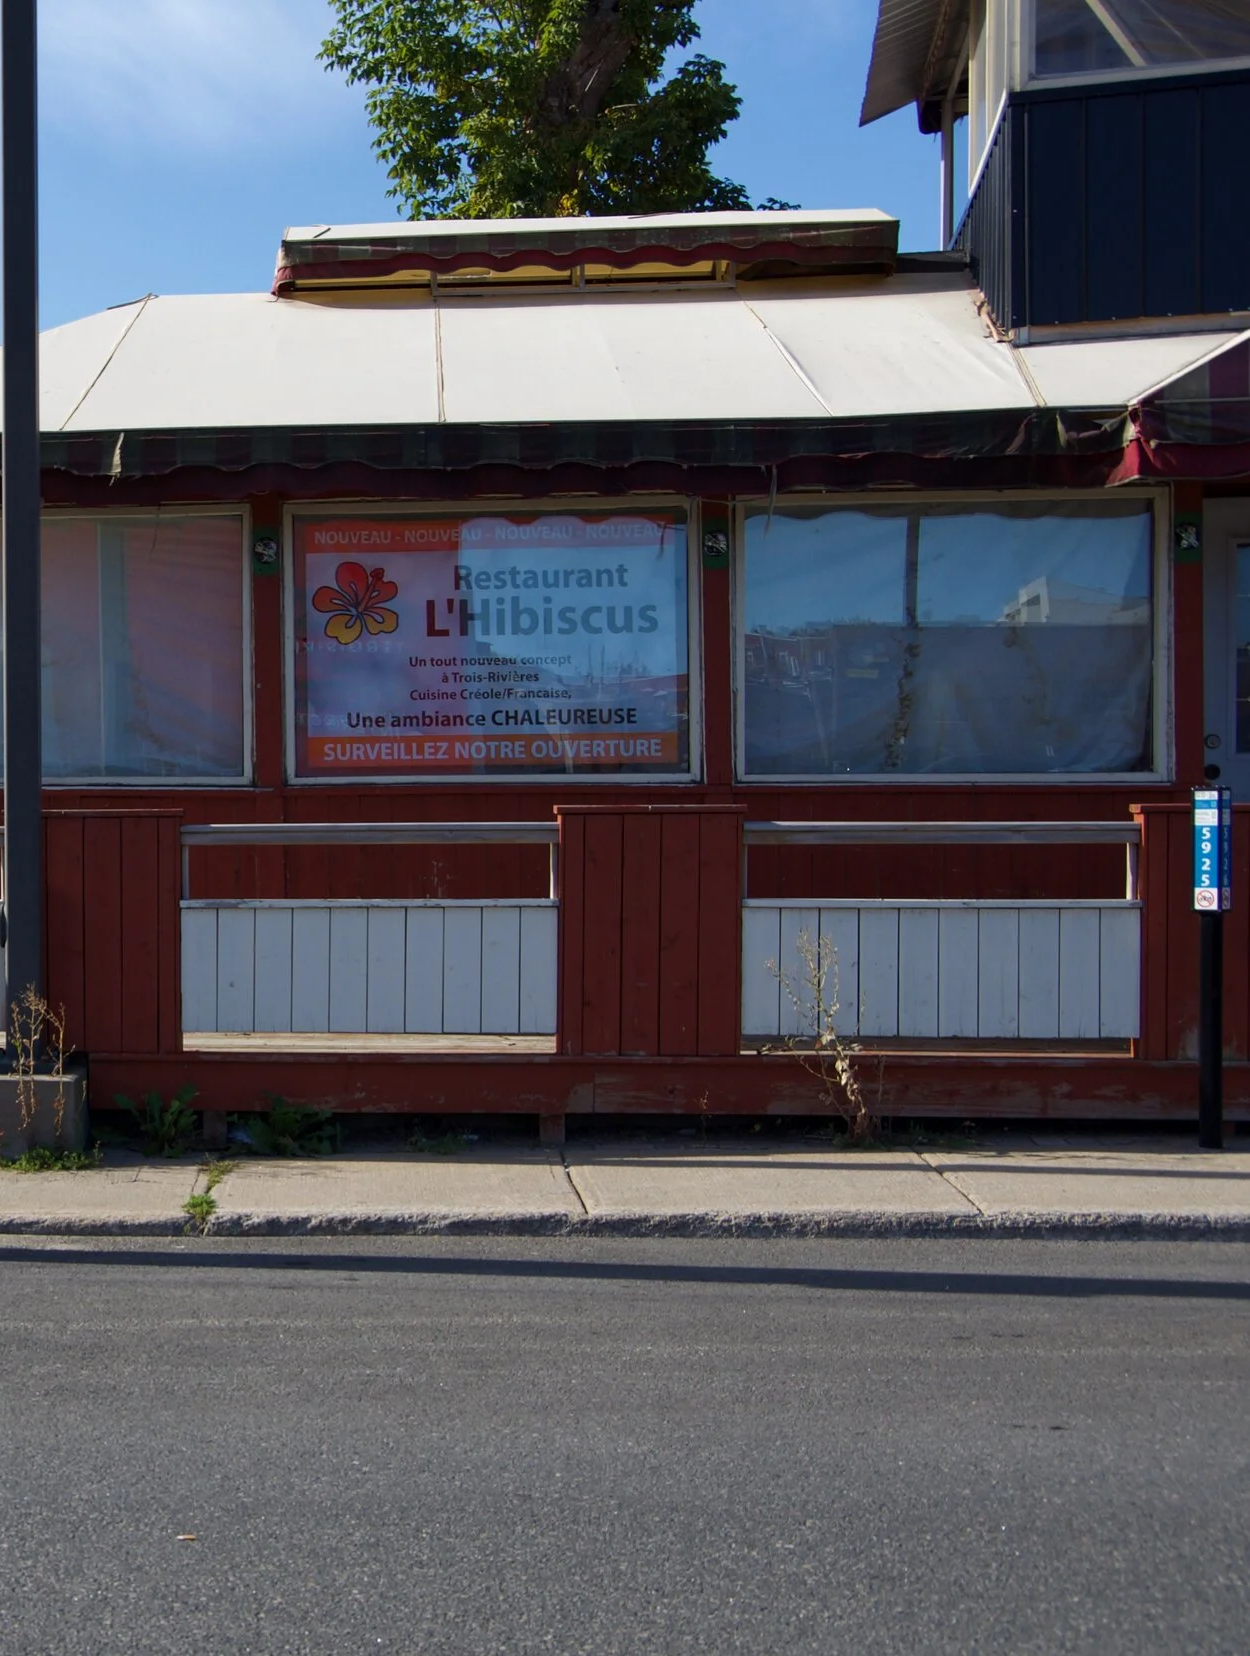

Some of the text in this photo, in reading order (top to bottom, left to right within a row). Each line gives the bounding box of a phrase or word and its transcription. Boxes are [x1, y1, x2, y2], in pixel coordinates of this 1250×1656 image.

[314, 530, 392, 545] NOUVEAU
[404, 528, 482, 543] NOUVEAU
[495, 525, 572, 540] NOUVEAU
[453, 563, 629, 591] Restaurant
[425, 596, 660, 637] L'Hibiscus
[409, 654, 573, 668] Un tout nouveau concept
[441, 671, 540, 684] à Trois-Rivières
[409, 689, 457, 701] Cuisine
[347, 712, 386, 729] Une
[390, 710, 487, 729] ambiance
[491, 707, 638, 727] CHALEUREUSE
[323, 738, 663, 762] SURVEILLEZ NOTRE OUVERTURE
[1200, 827, 1212, 887] 5925
